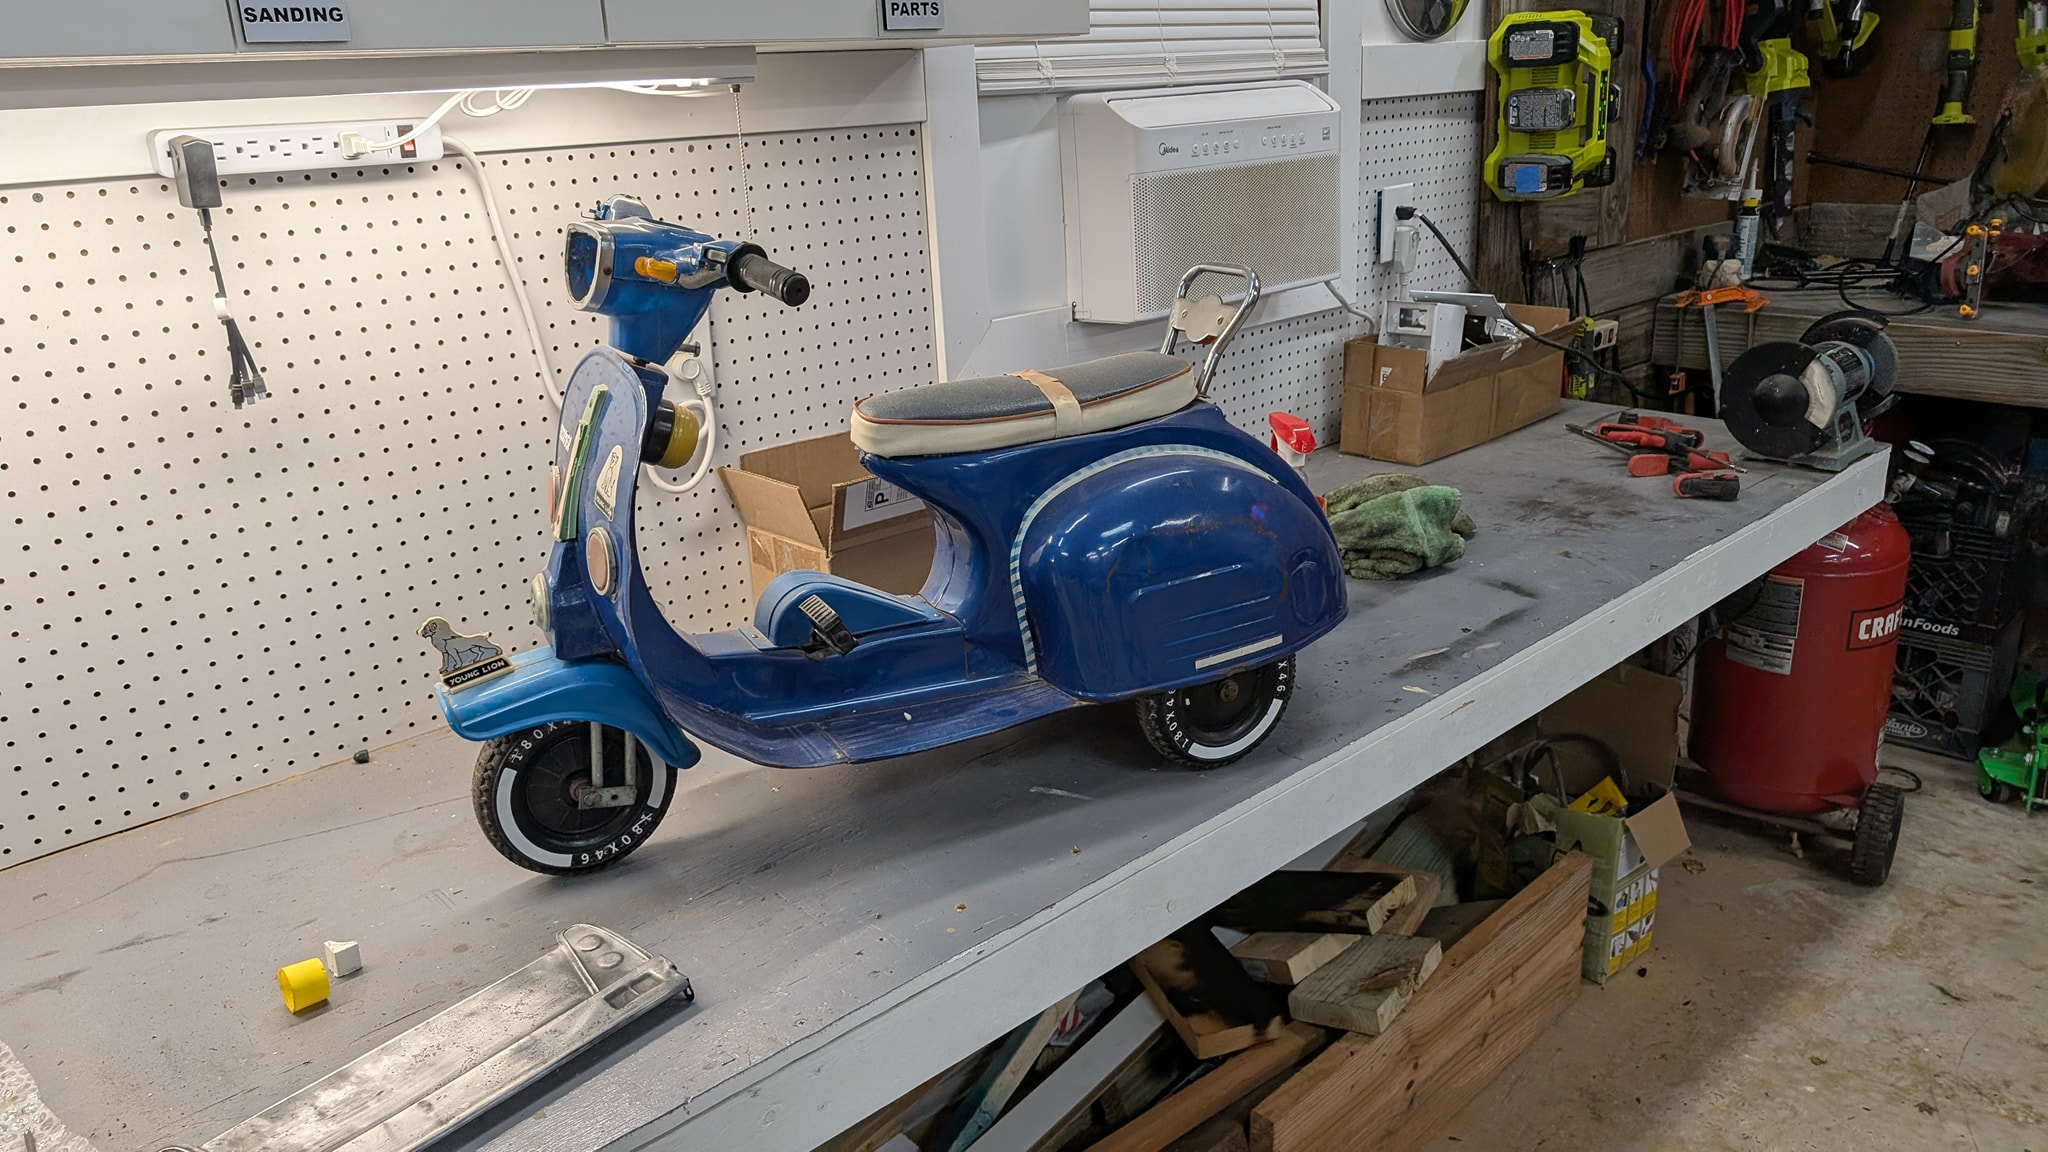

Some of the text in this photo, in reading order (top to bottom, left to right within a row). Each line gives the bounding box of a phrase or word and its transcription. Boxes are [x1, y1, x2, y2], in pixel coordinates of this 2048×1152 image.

[243, 7, 344, 23] SANDING
[891, 2, 940, 17] PARTS
[1900, 617, 1960, 636] nFoods
[449, 660, 505, 686] YOUNG LION
[580, 812, 654, 865] 180X46
